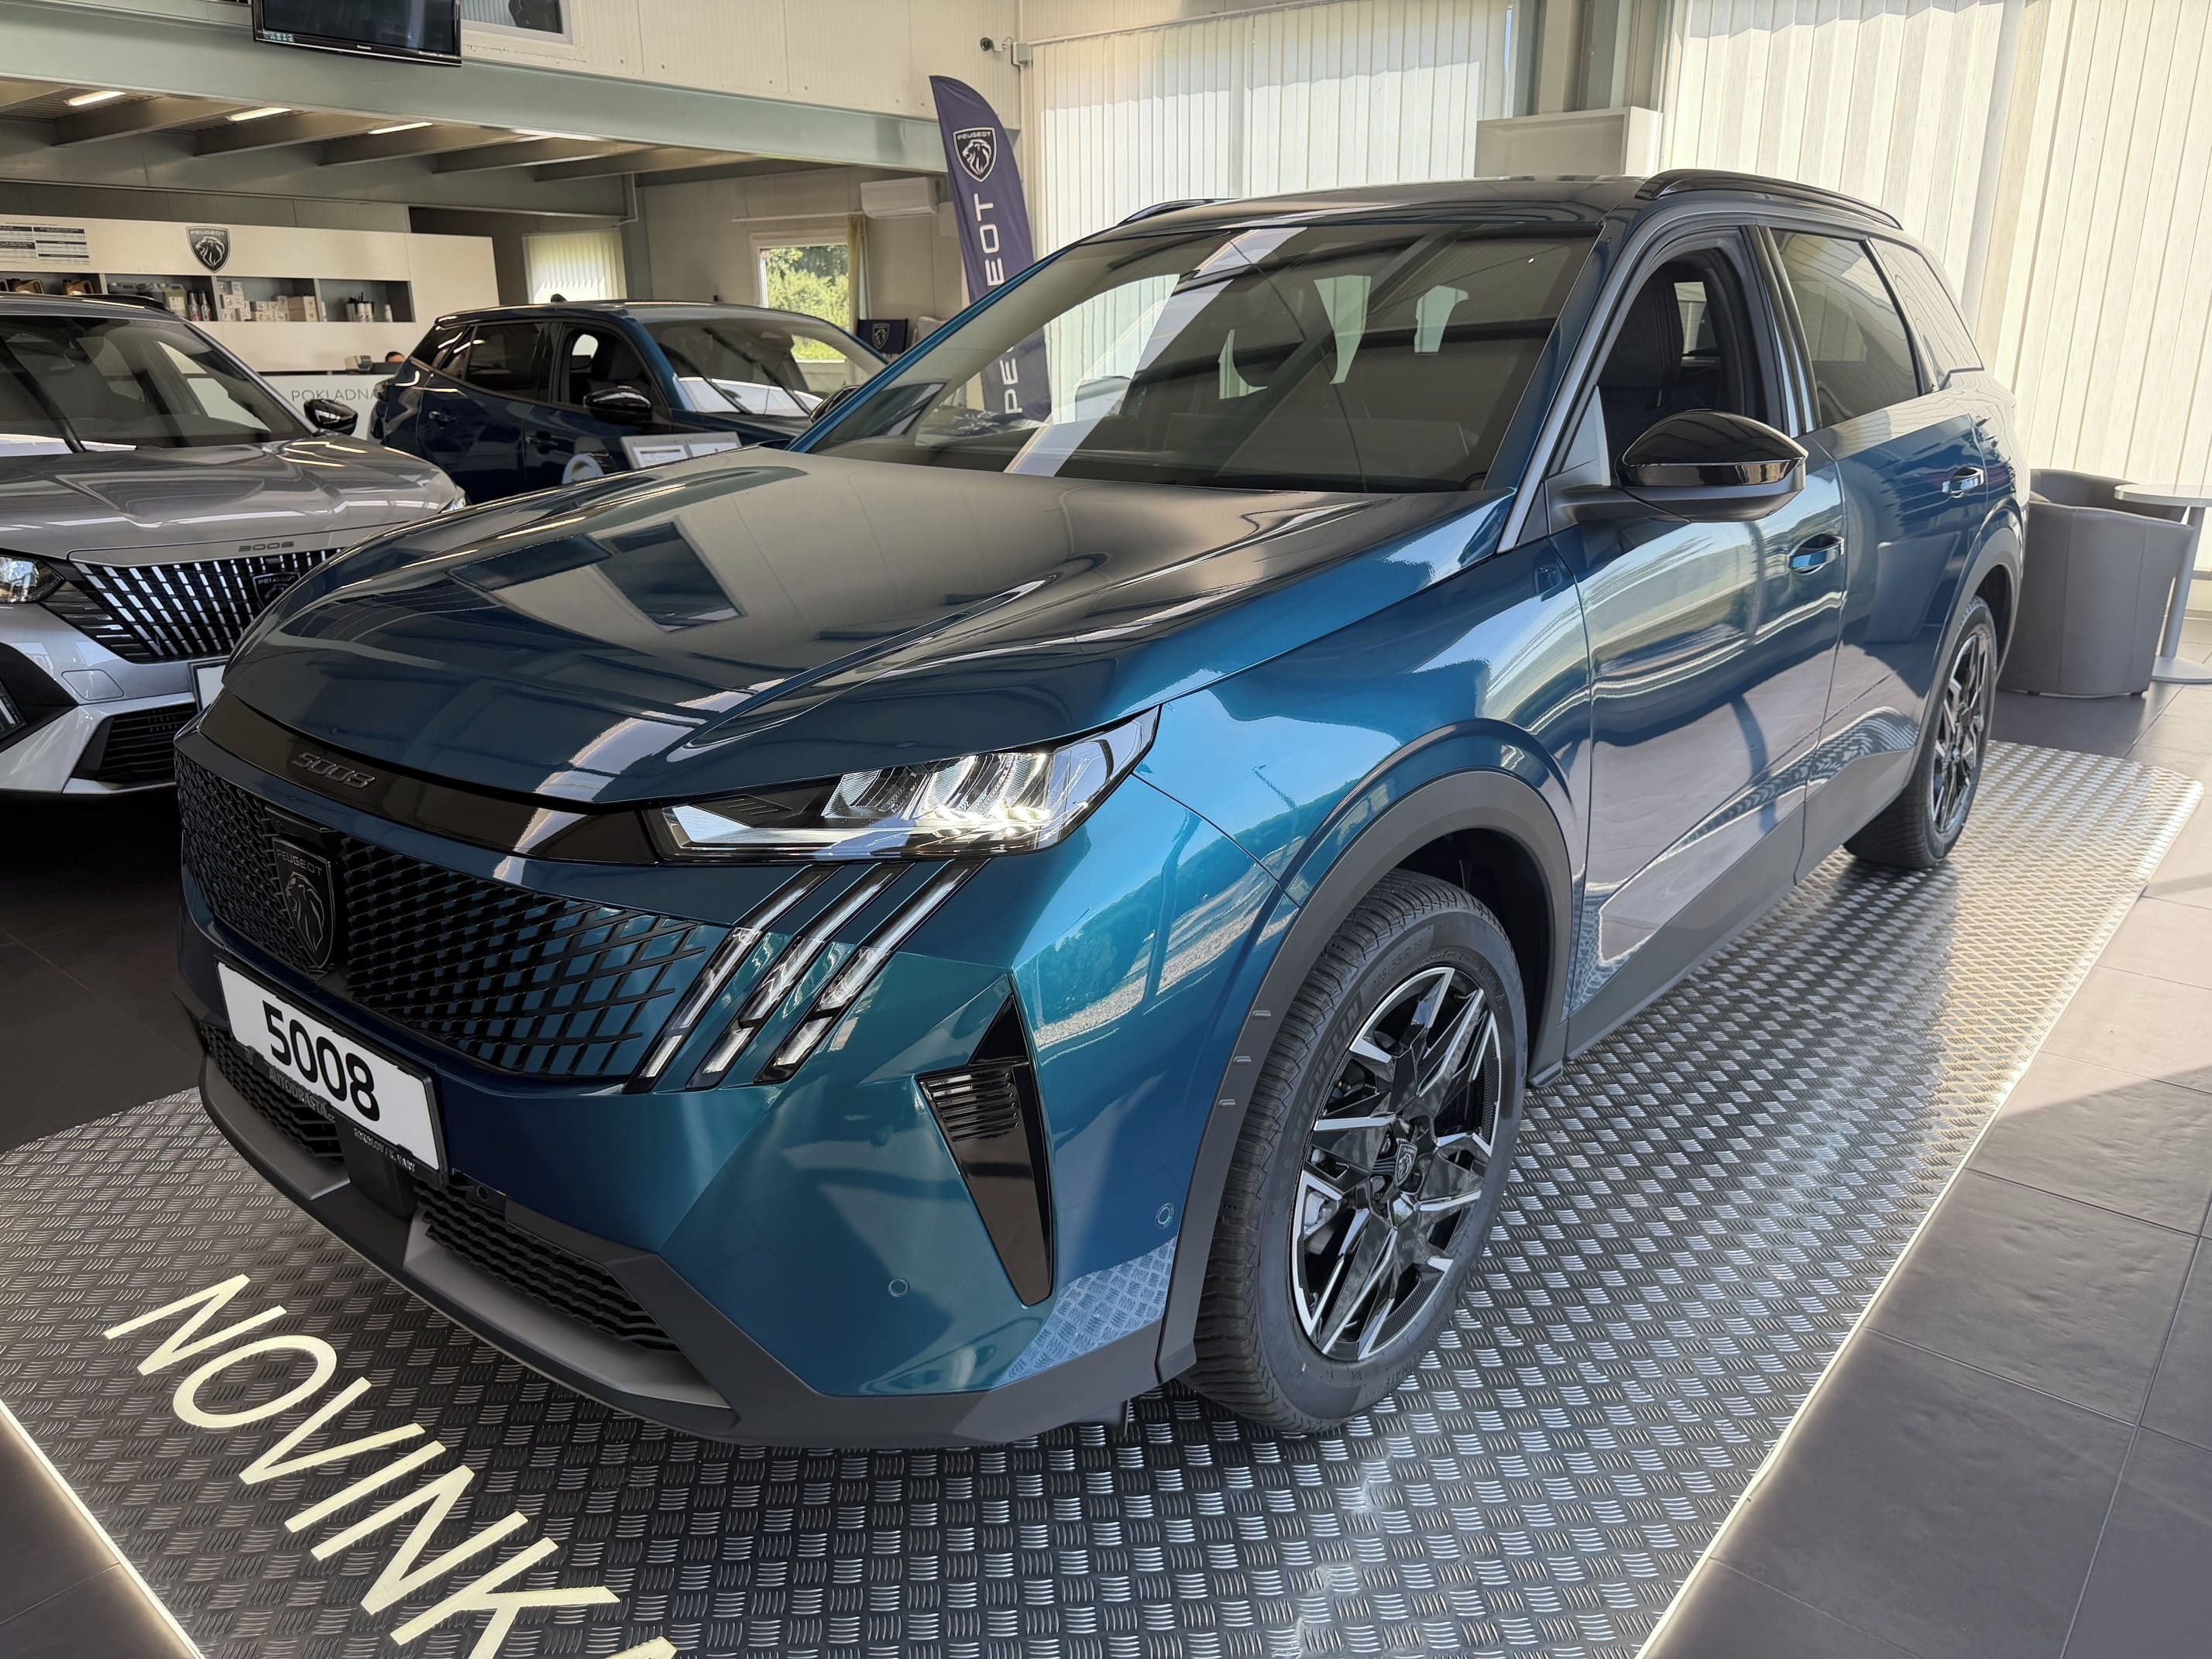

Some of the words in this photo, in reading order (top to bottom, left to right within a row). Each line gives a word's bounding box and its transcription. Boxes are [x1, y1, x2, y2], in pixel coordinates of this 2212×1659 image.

[290, 751, 376, 789] 5008
[276, 849, 323, 877] PEUGEOT
[262, 999, 380, 1122] 5008
[104, 1274, 677, 1659] NOVINK
